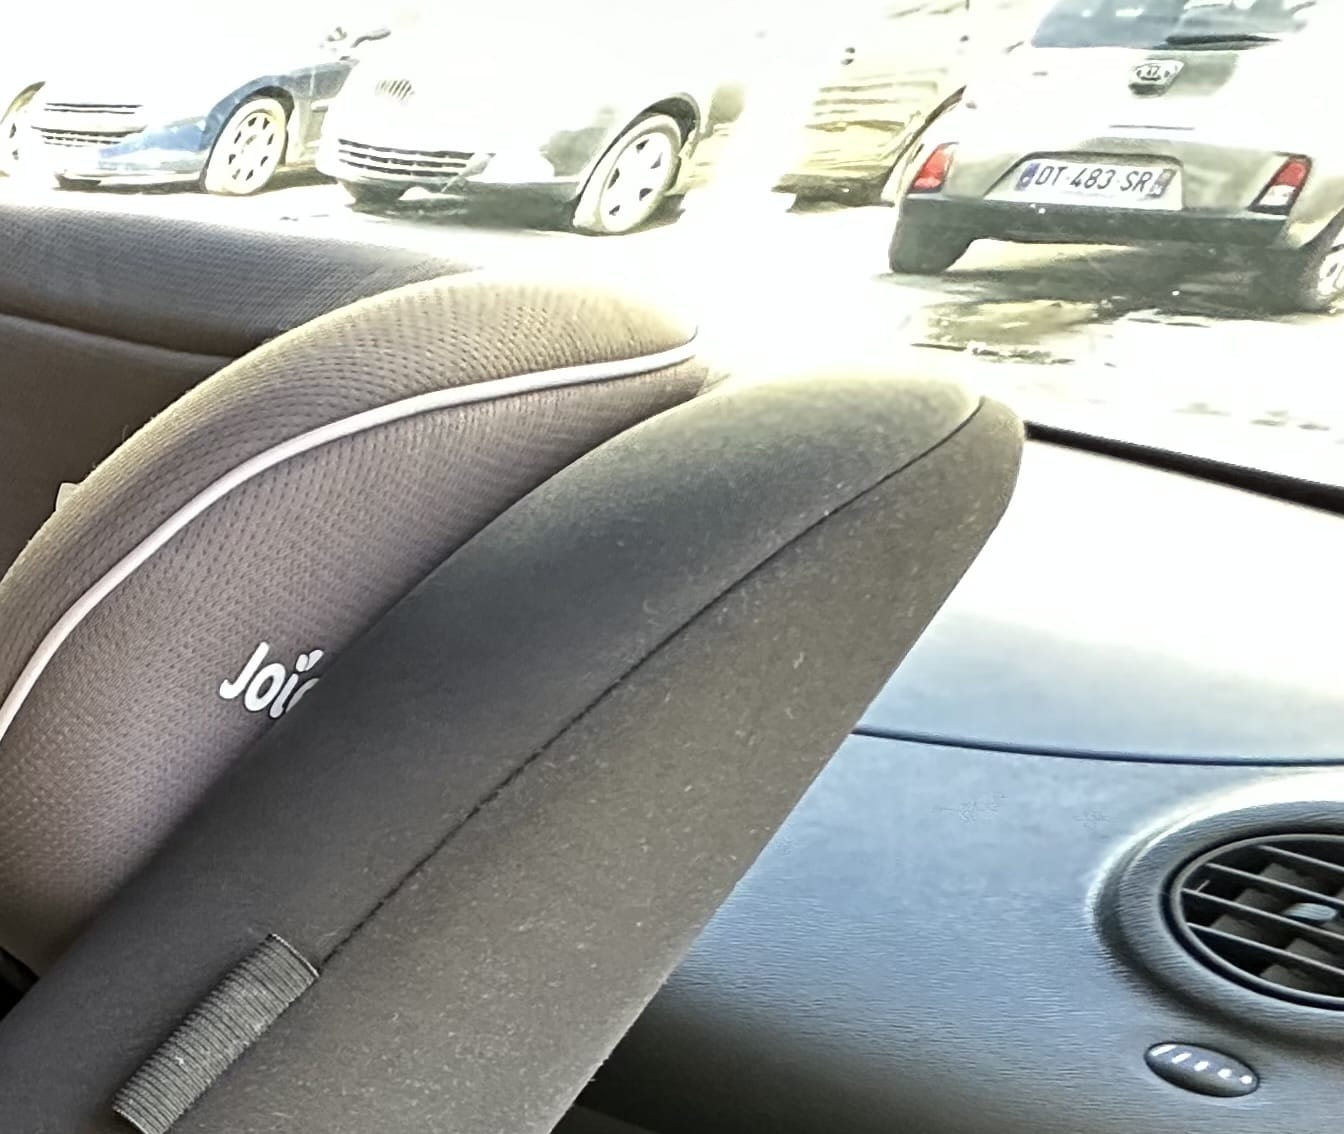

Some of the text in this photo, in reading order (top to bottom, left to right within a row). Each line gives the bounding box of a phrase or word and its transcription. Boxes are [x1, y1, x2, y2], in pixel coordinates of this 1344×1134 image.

[1034, 166, 1154, 193] DT 483 SR
